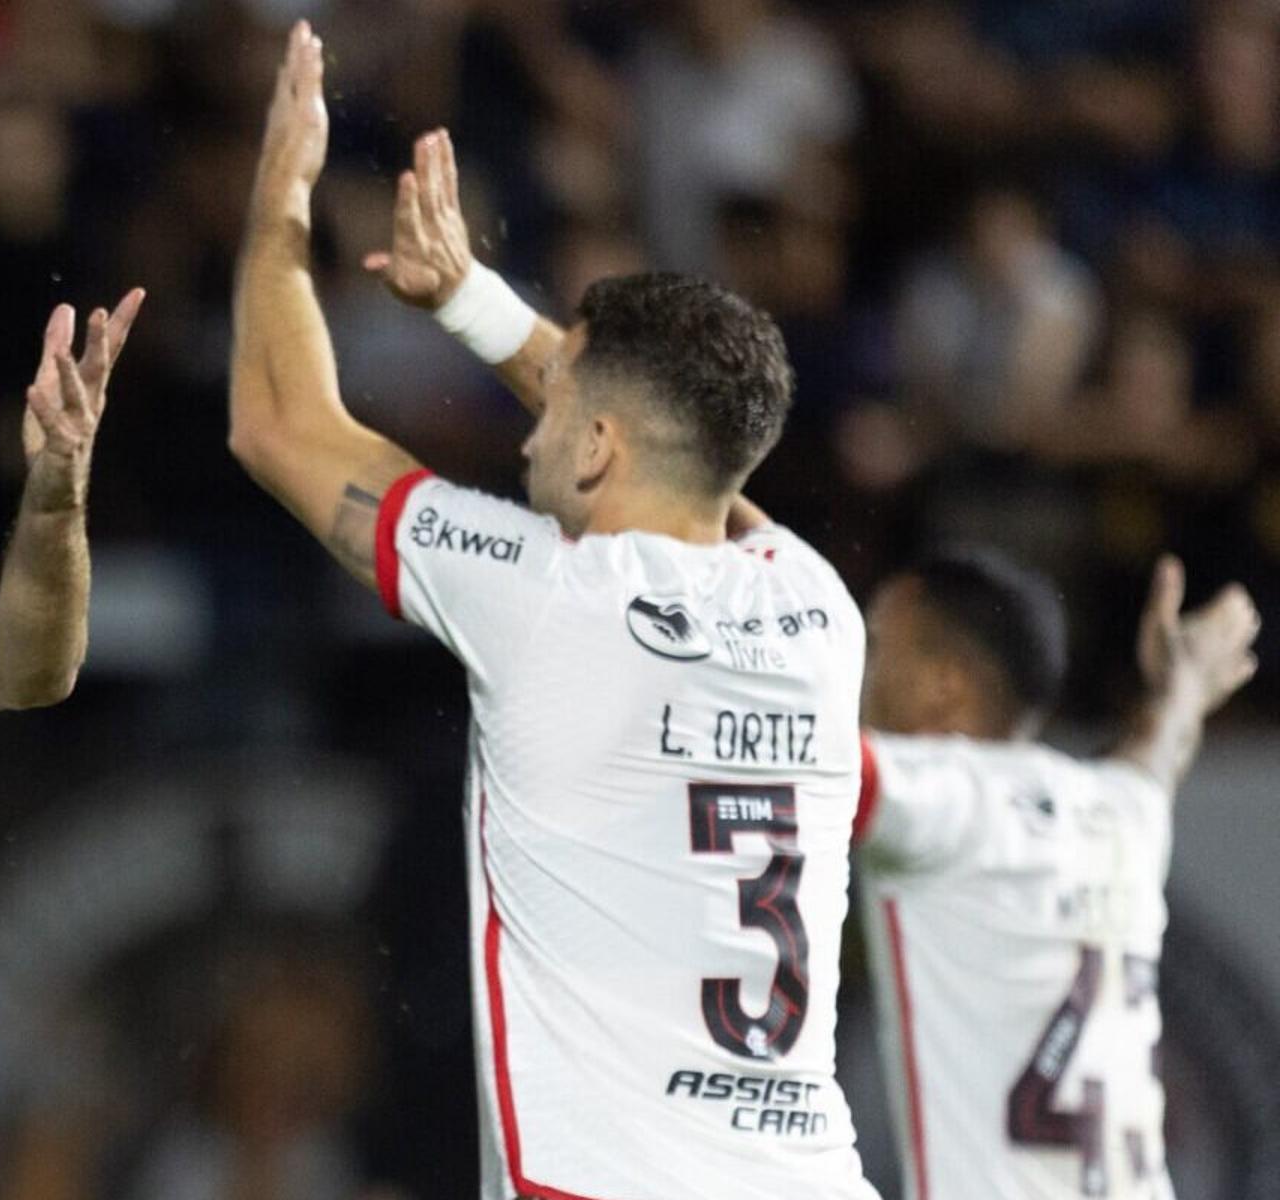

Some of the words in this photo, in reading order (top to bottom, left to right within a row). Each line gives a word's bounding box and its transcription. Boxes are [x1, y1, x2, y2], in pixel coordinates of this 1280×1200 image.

[437, 517, 525, 565] kwai
[661, 704, 694, 758] L.
[714, 710, 818, 766] ORTIZ
[738, 796, 773, 822] TIM
[686, 781, 810, 1063] 3
[665, 1069, 822, 1107] ASSIST
